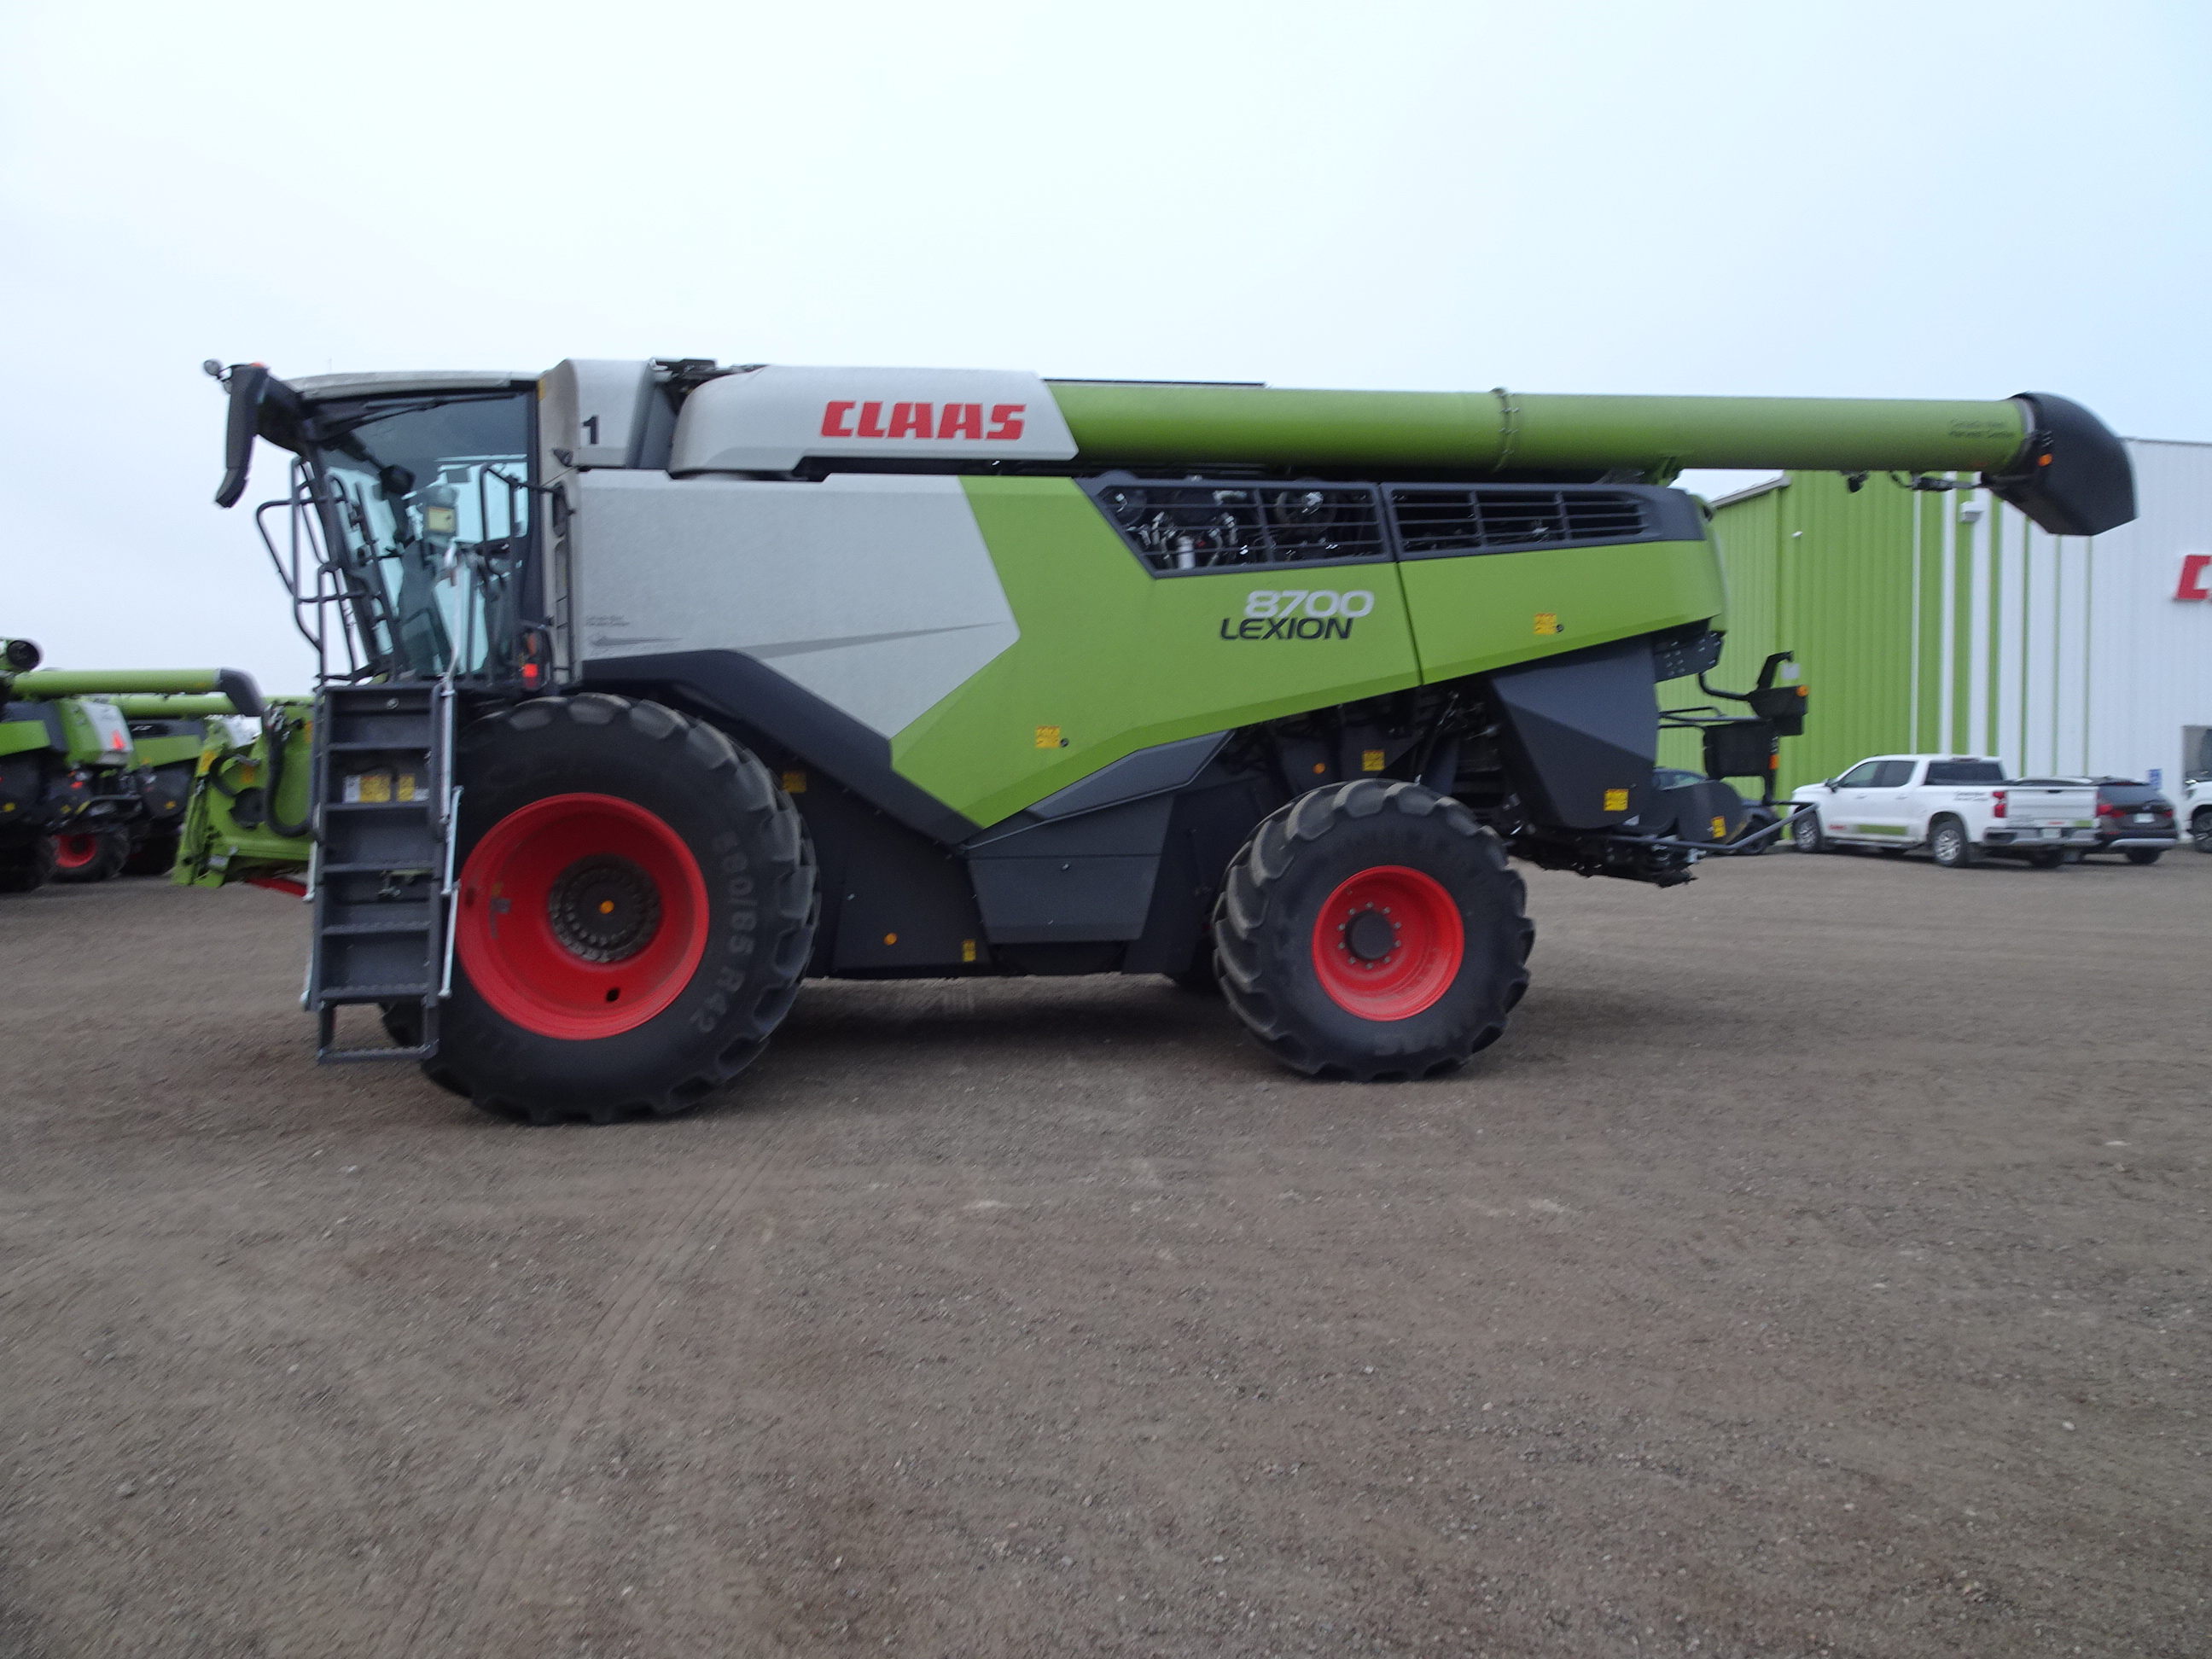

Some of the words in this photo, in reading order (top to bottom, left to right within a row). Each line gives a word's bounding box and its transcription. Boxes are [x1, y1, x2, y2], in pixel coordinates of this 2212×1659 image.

[582, 415, 599, 445] 1
[821, 400, 1027, 439] CLAAS
[1244, 590, 1375, 618] 8700
[1220, 617, 1353, 640] LEXION
